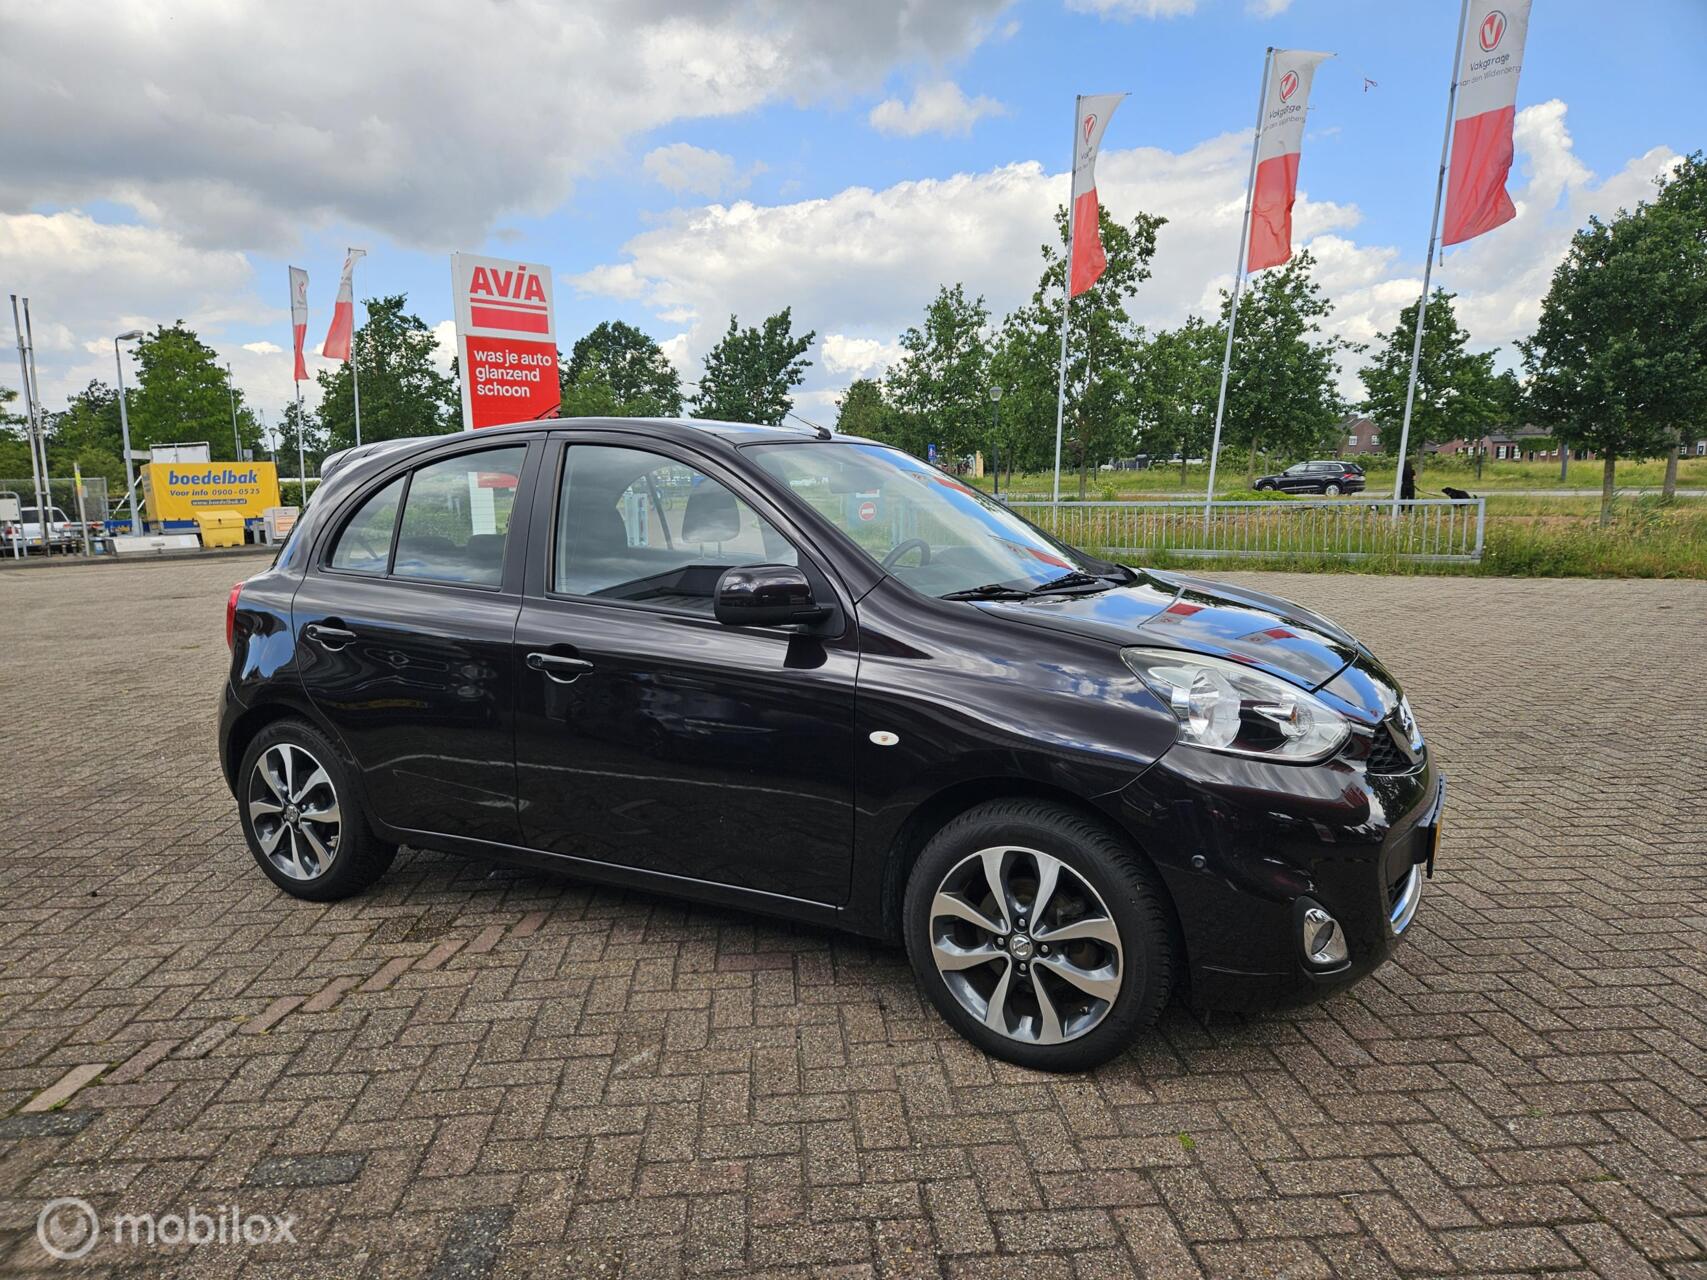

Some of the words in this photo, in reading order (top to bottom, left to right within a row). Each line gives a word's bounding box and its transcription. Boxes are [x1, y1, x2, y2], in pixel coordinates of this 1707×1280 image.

[1470, 53, 1510, 71] Vakgarage
[474, 350, 504, 363] was
[505, 350, 519, 367] je
[520, 353, 552, 366] auto
[475, 366, 540, 382] glanzend
[477, 382, 530, 398] schoon
[169, 470, 257, 485] boedelbak
[169, 489, 190, 497] Voor
[191, 489, 209, 497] info
